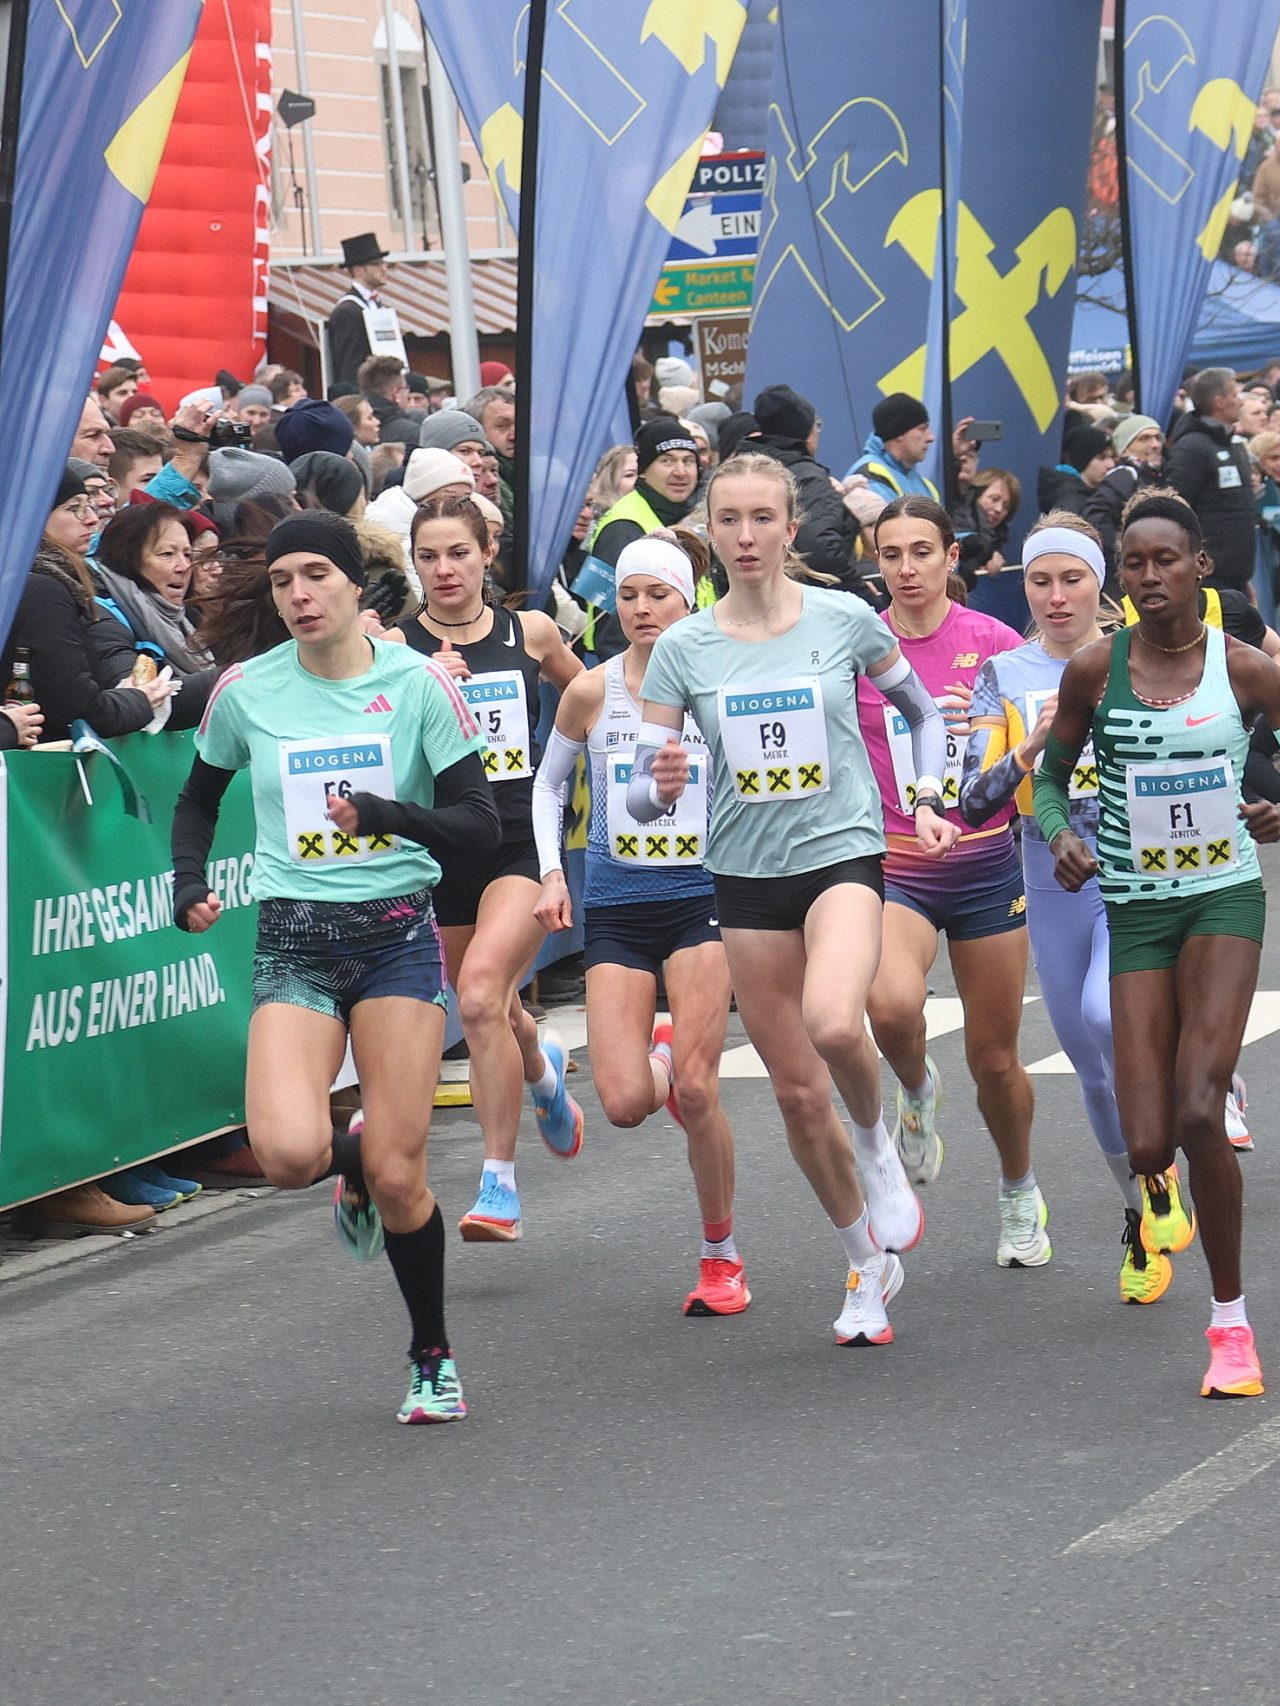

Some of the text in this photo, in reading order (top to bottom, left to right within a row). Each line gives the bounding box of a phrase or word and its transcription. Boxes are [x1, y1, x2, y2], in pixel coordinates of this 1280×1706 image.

[700, 163, 766, 186] POLIZ
[721, 214, 756, 236] EIN
[462, 686, 514, 700] OGENA
[730, 694, 809, 712] BIOGENA
[759, 721, 787, 749] F9
[293, 751, 378, 769] BIOGENA
[1141, 774, 1222, 792] BIOGENA
[1169, 802, 1194, 829] F1
[32, 890, 96, 956] IHRE
[25, 952, 226, 1052] AUS EINER HAND.
